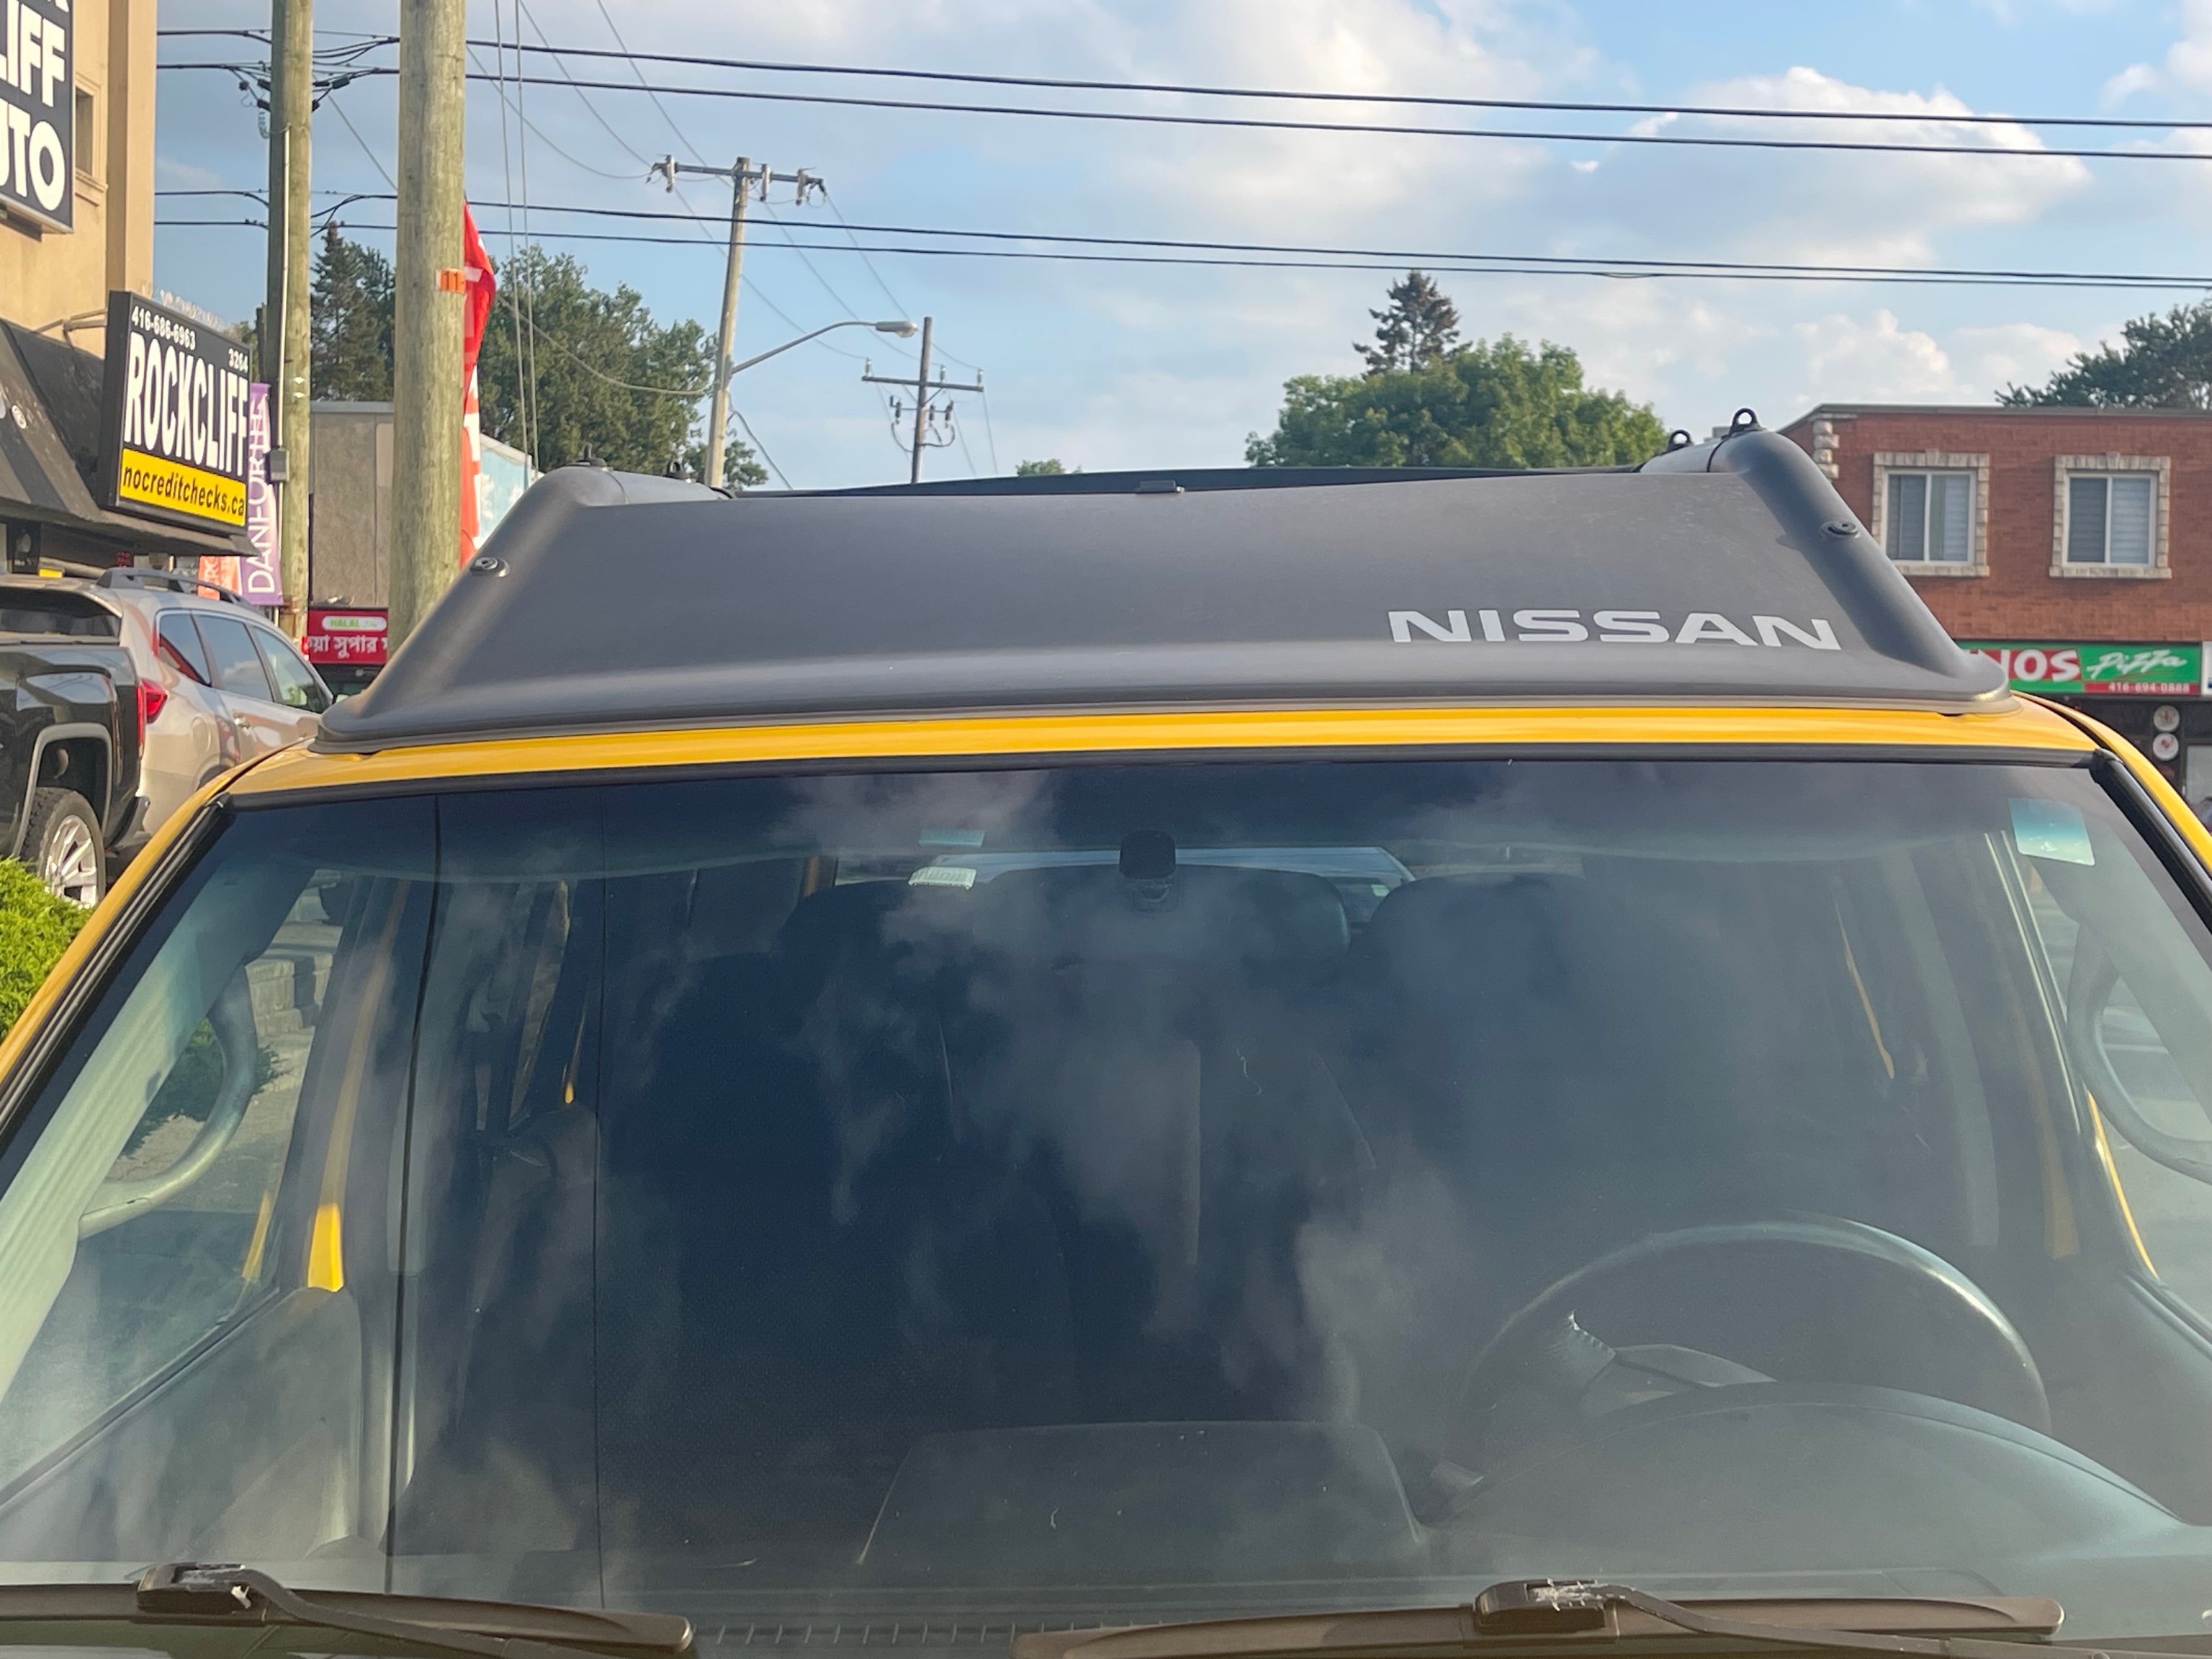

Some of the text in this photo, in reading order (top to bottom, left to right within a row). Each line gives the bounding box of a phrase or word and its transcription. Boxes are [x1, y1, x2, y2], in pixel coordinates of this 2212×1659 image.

[132, 305, 195, 351] 416-686-6963
[123, 331, 248, 477] ROCKCLIFF
[123, 465, 244, 516] nocreditchecks.ca
[330, 618, 360, 628] HALAL
[1388, 608, 1841, 650] NISSAN
[2086, 649, 2188, 680] Pizza
